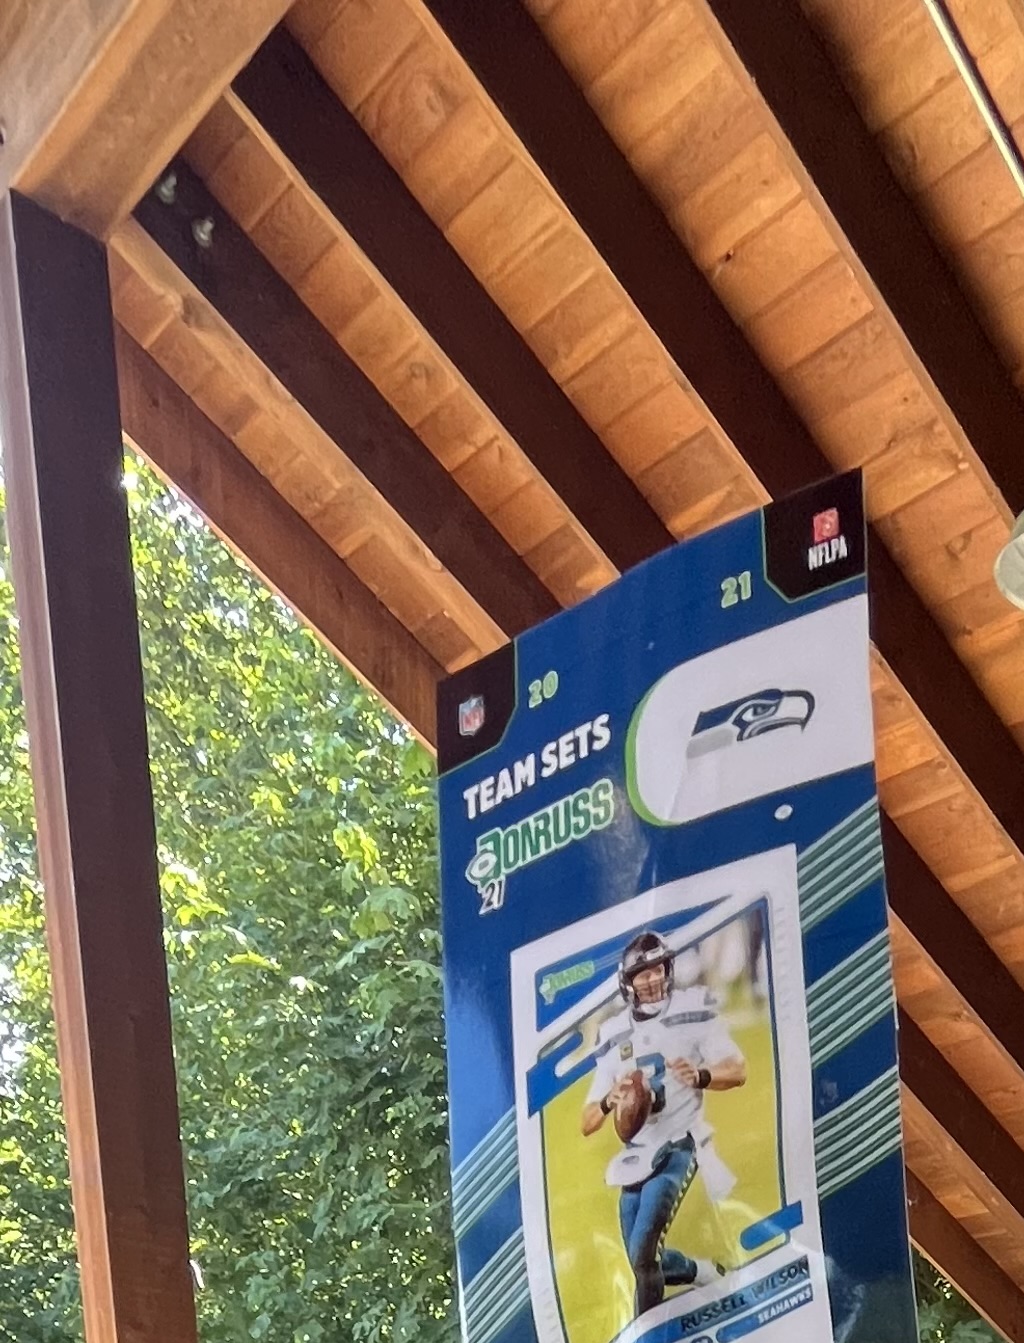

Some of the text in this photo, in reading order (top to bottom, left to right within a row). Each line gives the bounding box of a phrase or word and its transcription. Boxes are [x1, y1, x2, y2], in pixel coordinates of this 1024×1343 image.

[808, 535, 848, 571] NFLPA
[720, 570, 752, 608] 21
[527, 671, 559, 708] 20
[462, 713, 611, 819] TEAM SETS
[680, 1254, 812, 1333] RUSSELL WILSON
